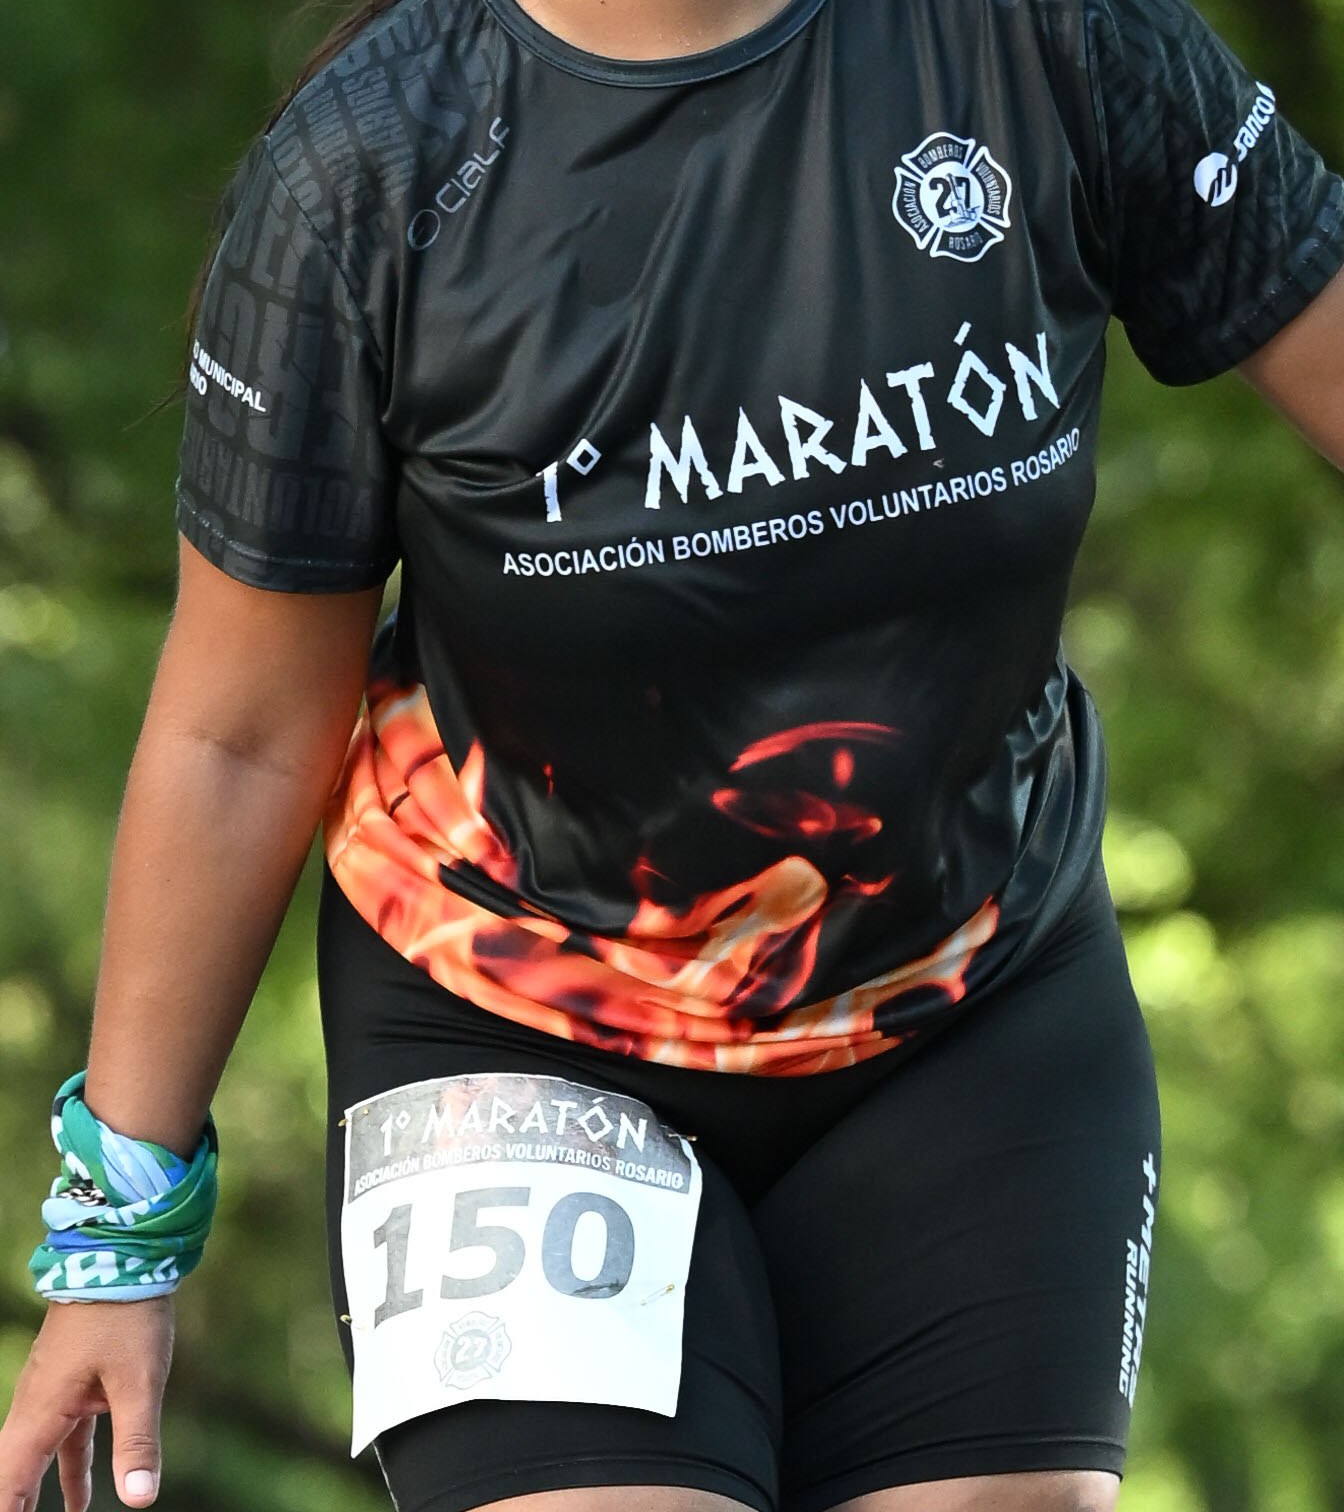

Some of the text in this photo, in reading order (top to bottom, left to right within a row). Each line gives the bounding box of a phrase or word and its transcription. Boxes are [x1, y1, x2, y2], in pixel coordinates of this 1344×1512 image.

[917, 144, 963, 169] BOMBEROS
[928, 175, 971, 219] 27
[975, 161, 1001, 215] VOLUNTARIOS
[198, 348, 267, 413] MUNICIPAL
[644, 320, 1060, 509] MARATÓN
[503, 427, 1081, 577] ASOCIACIÓN BOMBEROS VOLUNTARIOS ROSARIO
[420, 1096, 648, 1153] MARATÓN
[354, 1143, 684, 1197] ASOCIACIÓN BOMBEROS VOLUNTARIOS ROSARIO
[373, 1186, 636, 1330] 150
[1118, 1238, 1138, 1398] RUNNING
[455, 1334, 489, 1364] 27
